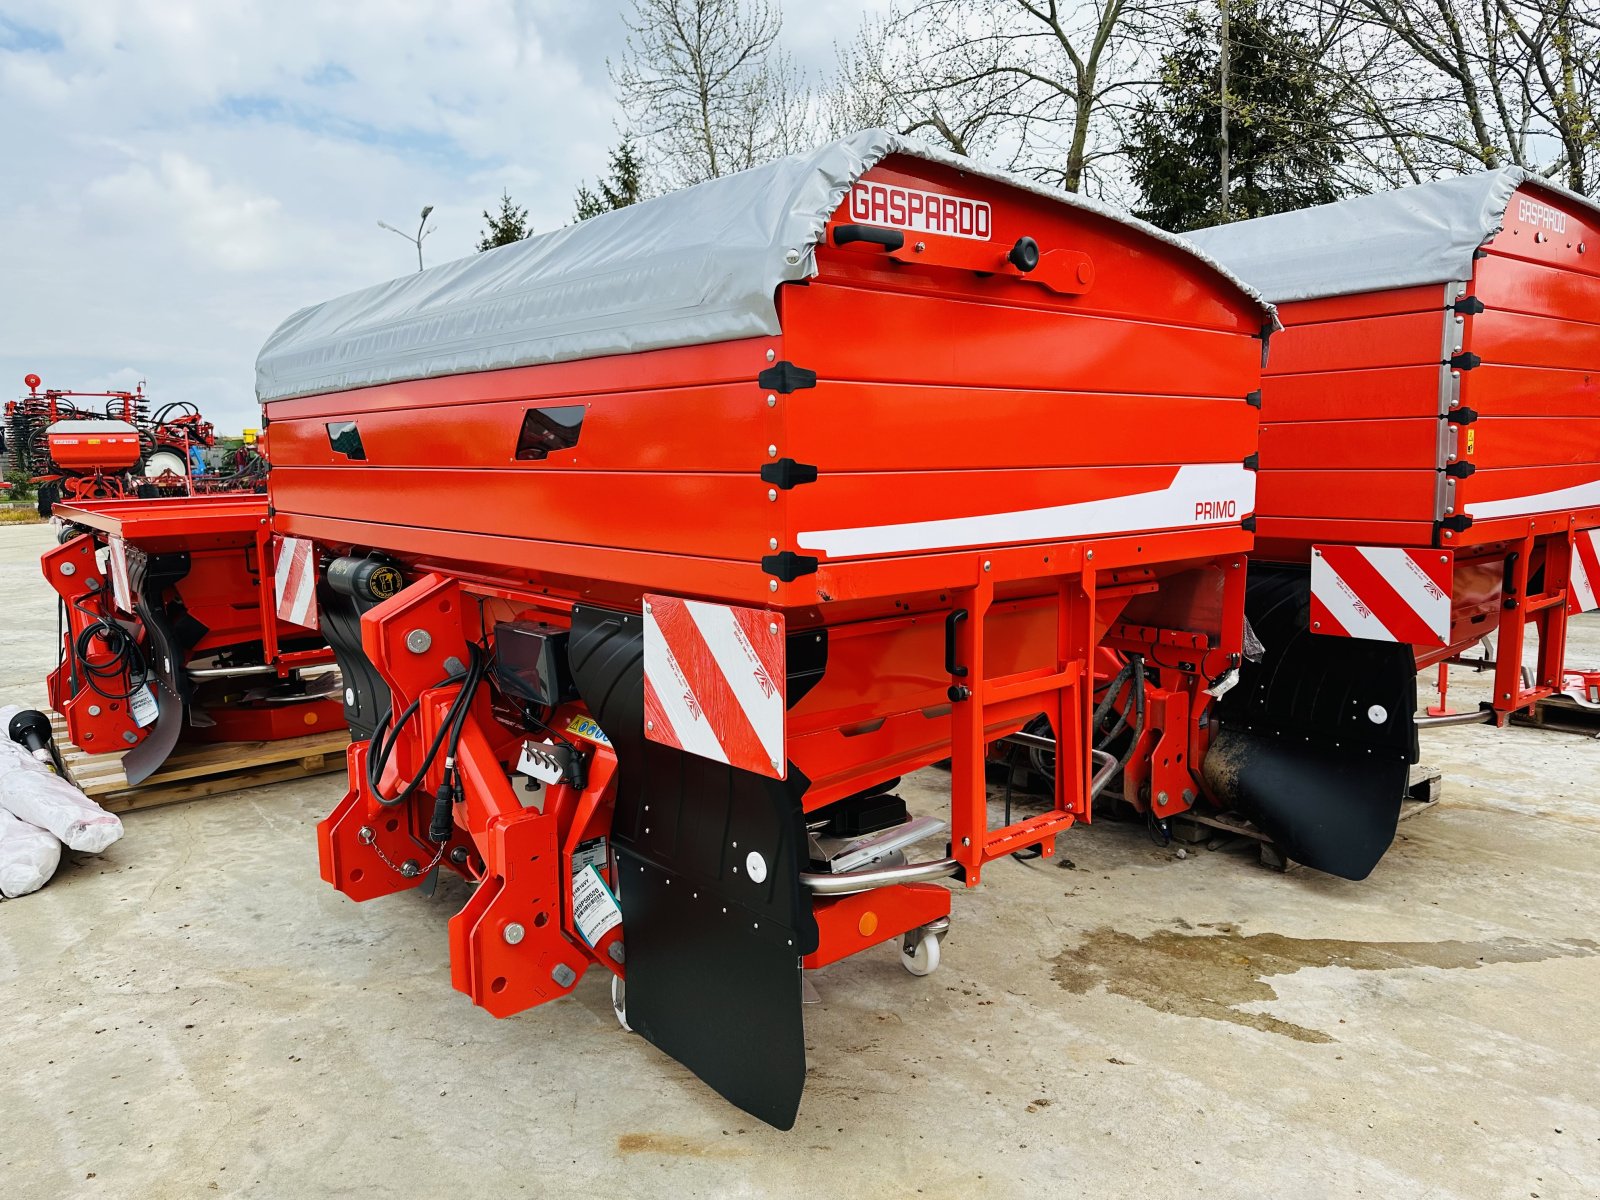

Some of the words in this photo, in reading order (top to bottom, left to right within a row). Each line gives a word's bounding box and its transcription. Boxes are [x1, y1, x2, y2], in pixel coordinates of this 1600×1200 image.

[852, 184, 989, 238] GASPARDO
[1519, 199, 1566, 234] GASPARDO
[1195, 500, 1236, 520] PRIMO
